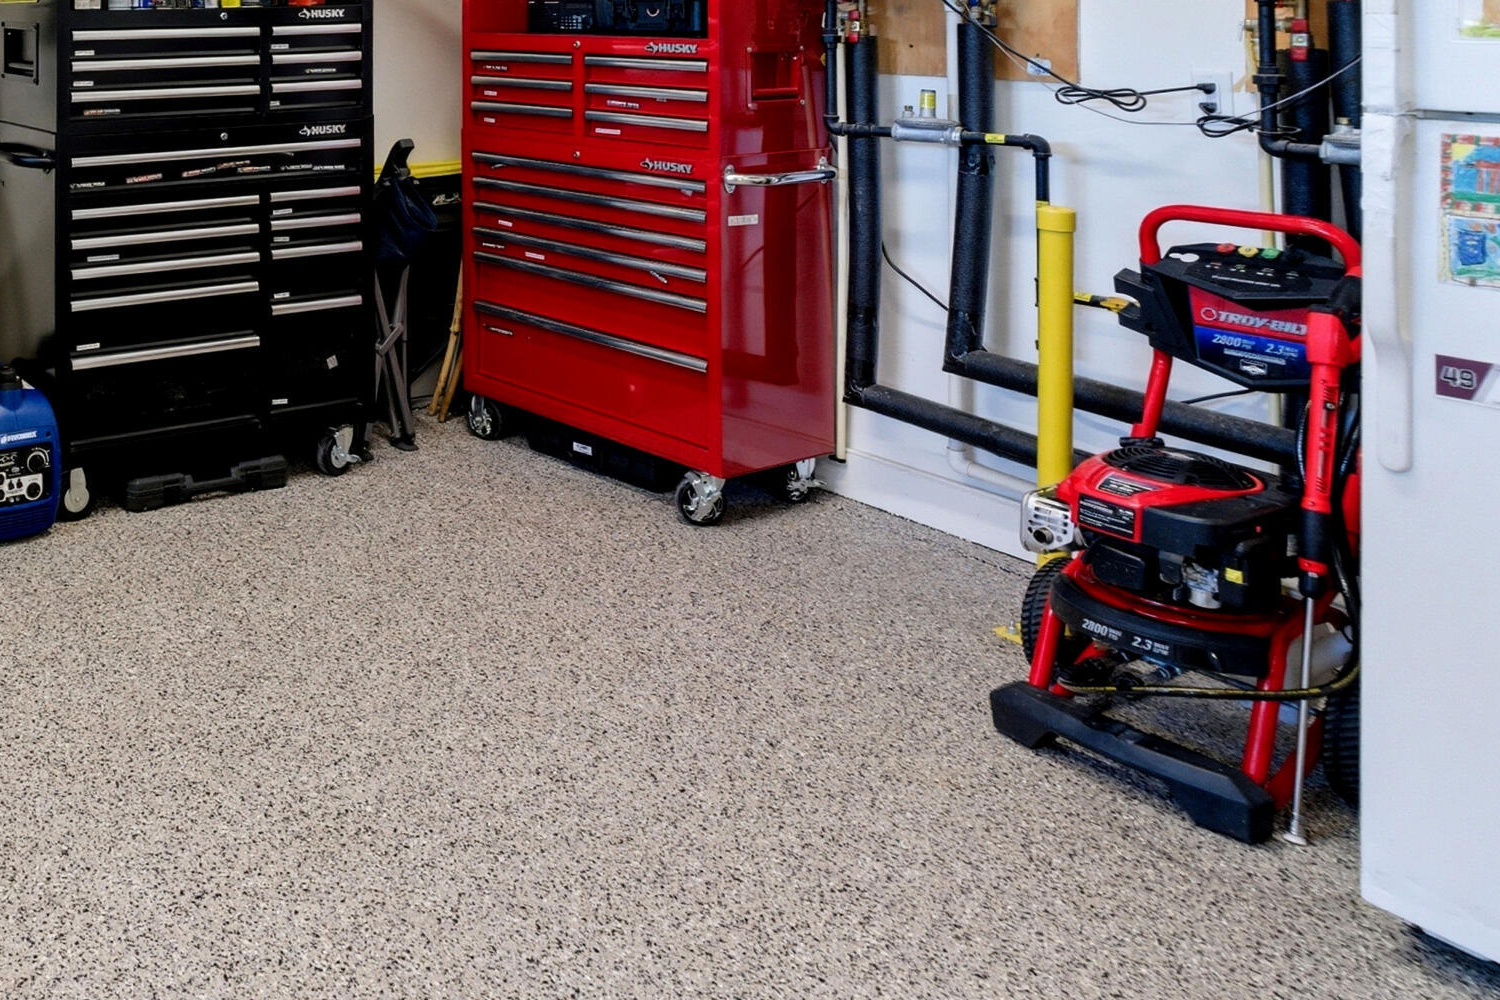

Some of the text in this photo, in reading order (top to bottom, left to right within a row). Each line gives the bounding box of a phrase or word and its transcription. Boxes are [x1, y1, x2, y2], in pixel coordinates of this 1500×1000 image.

[311, 8, 345, 18] HUSKY
[658, 43, 697, 54] HUSKY
[311, 124, 346, 135] HUSKY
[654, 161, 692, 173] HUSKY
[1440, 365, 1477, 390] 49
[1082, 618, 1108, 637] 2800
[1132, 636, 1152, 651] 2.3
